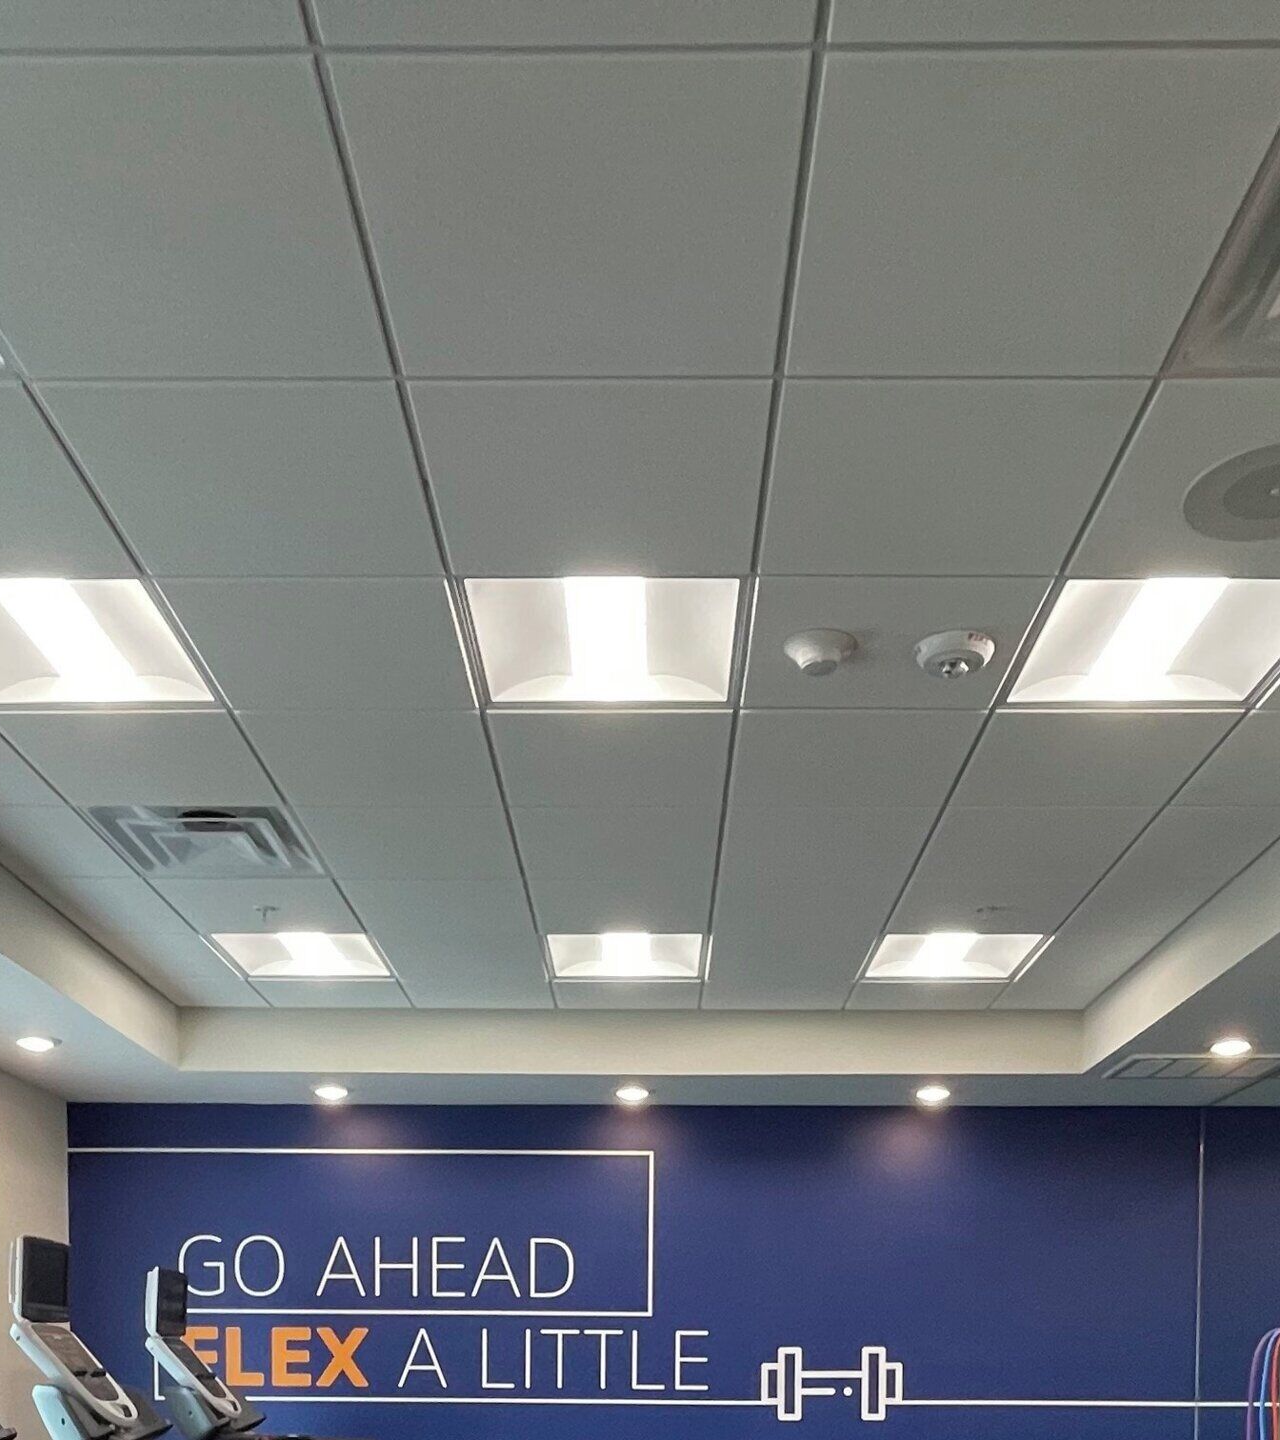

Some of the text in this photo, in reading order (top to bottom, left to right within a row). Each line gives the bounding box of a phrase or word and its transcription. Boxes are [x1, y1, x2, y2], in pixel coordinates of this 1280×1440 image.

[178, 1234, 575, 1298] GO AHEAD
[181, 1326, 709, 1390] FLEX A LITTLE
